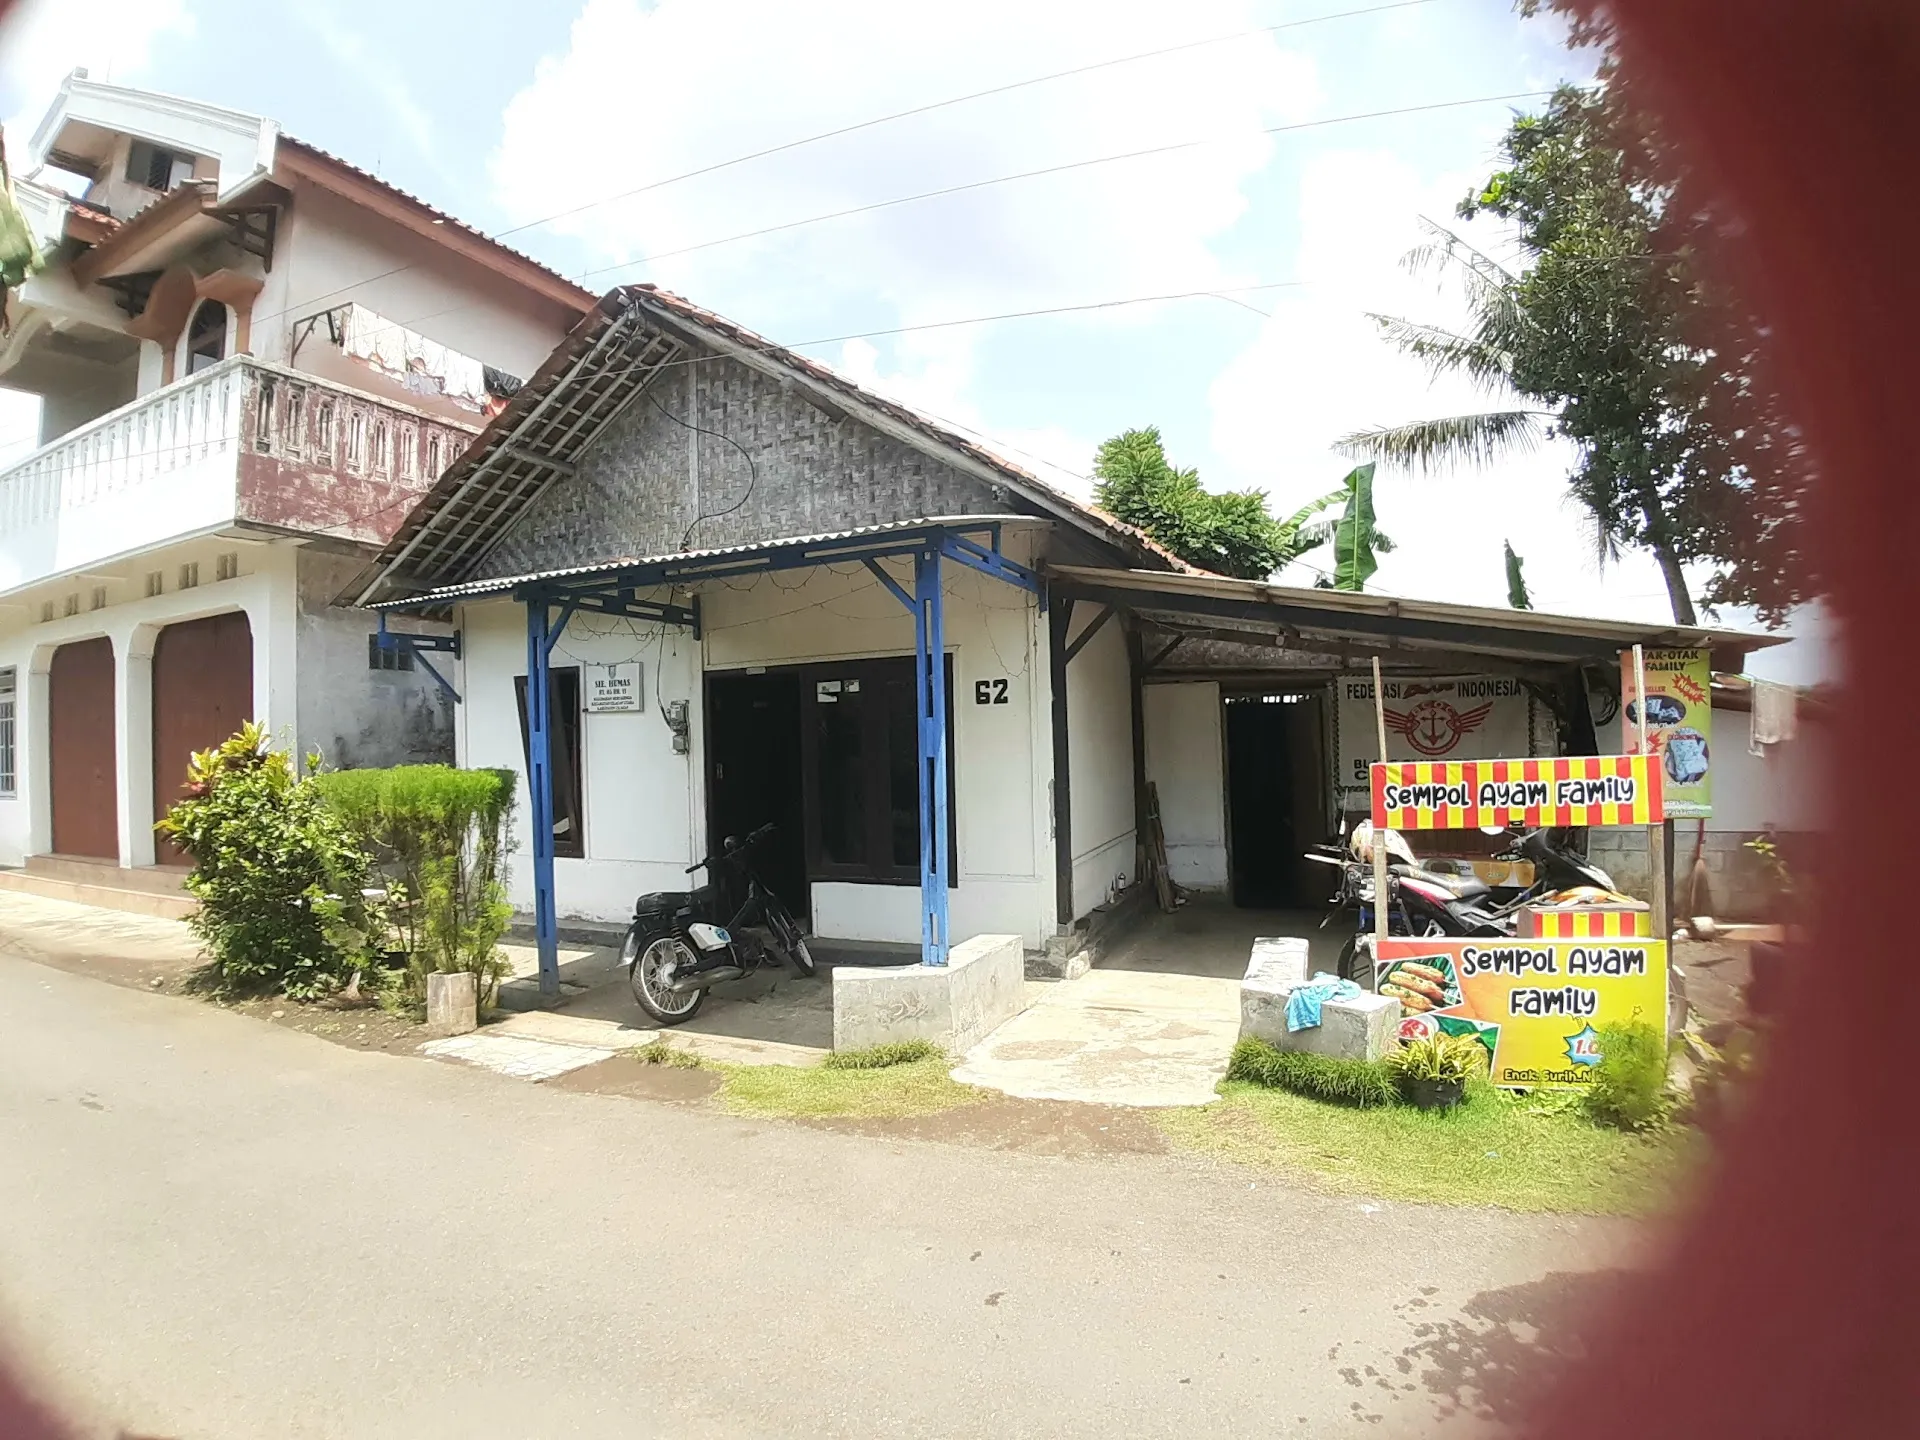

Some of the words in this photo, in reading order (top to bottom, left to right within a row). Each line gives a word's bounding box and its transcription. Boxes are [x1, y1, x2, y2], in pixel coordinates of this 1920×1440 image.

[1641, 650, 1699, 660] TAK-OTAK
[1645, 661, 1686, 671] FAMILY
[975, 678, 1009, 705] 62
[1346, 683, 1400, 699] FEDEASI
[1457, 680, 1522, 698] INDONESIA
[1385, 782, 1469, 809] Sempol
[1479, 782, 1548, 807] Ayam
[1556, 777, 1634, 806] Family
[1462, 947, 1558, 976] Sempol
[1568, 948, 1645, 975] Ayam
[1510, 986, 1597, 1015] Family
